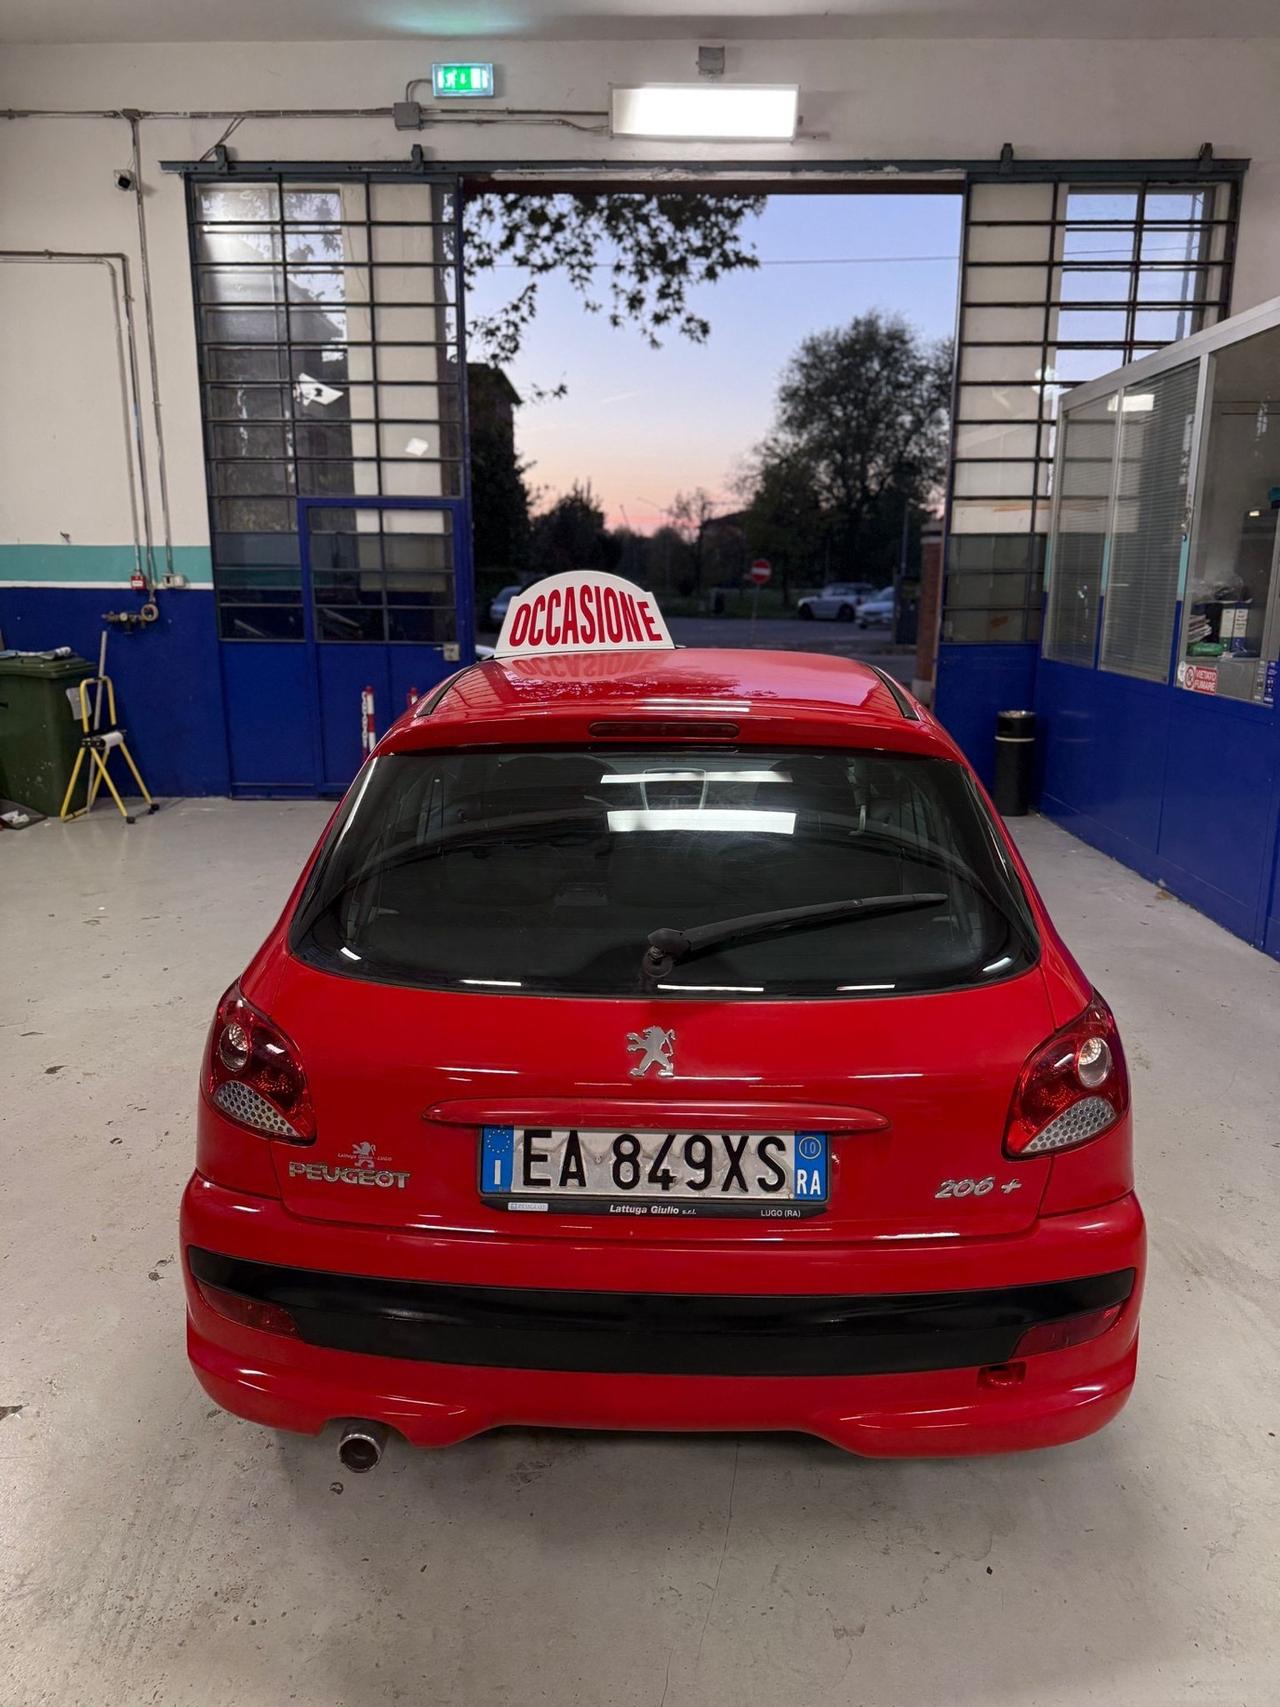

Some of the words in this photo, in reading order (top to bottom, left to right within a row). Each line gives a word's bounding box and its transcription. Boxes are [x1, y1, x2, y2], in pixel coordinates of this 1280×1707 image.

[509, 585, 663, 647] OCCASIONE
[289, 1161, 411, 1189] PEUGEOT
[523, 1130, 587, 1187] EA
[612, 1133, 787, 1193] 849XS
[797, 1169, 821, 1196] RA
[935, 1176, 996, 1200] 206
[609, 1204, 648, 1215] Lattuga
[650, 1205, 680, 1215] Giulio
[760, 1209, 783, 1217] LUGO
[784, 1209, 801, 1218] (RA)
